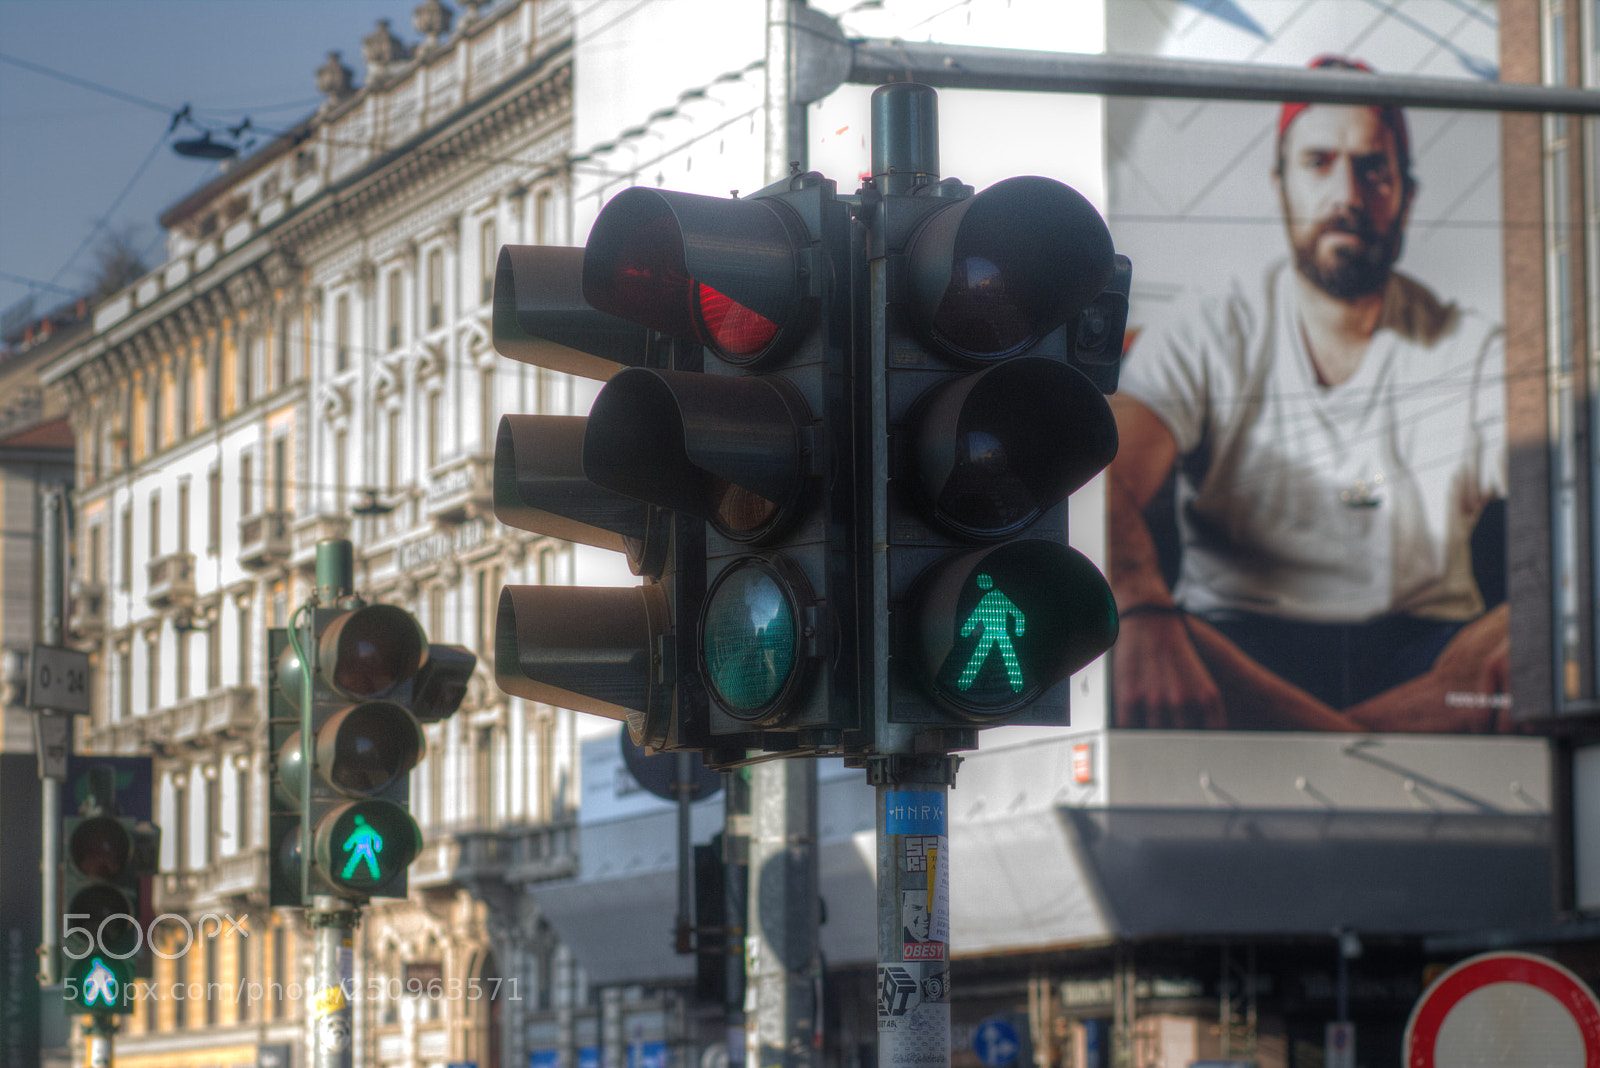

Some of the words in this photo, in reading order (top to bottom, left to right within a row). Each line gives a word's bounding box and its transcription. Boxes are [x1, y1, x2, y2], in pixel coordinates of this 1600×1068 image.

[41, 665, 50, 690] 0
[67, 669, 84, 693] 24
[895, 805, 940, 821] HNRX
[904, 944, 943, 958] OBESY
